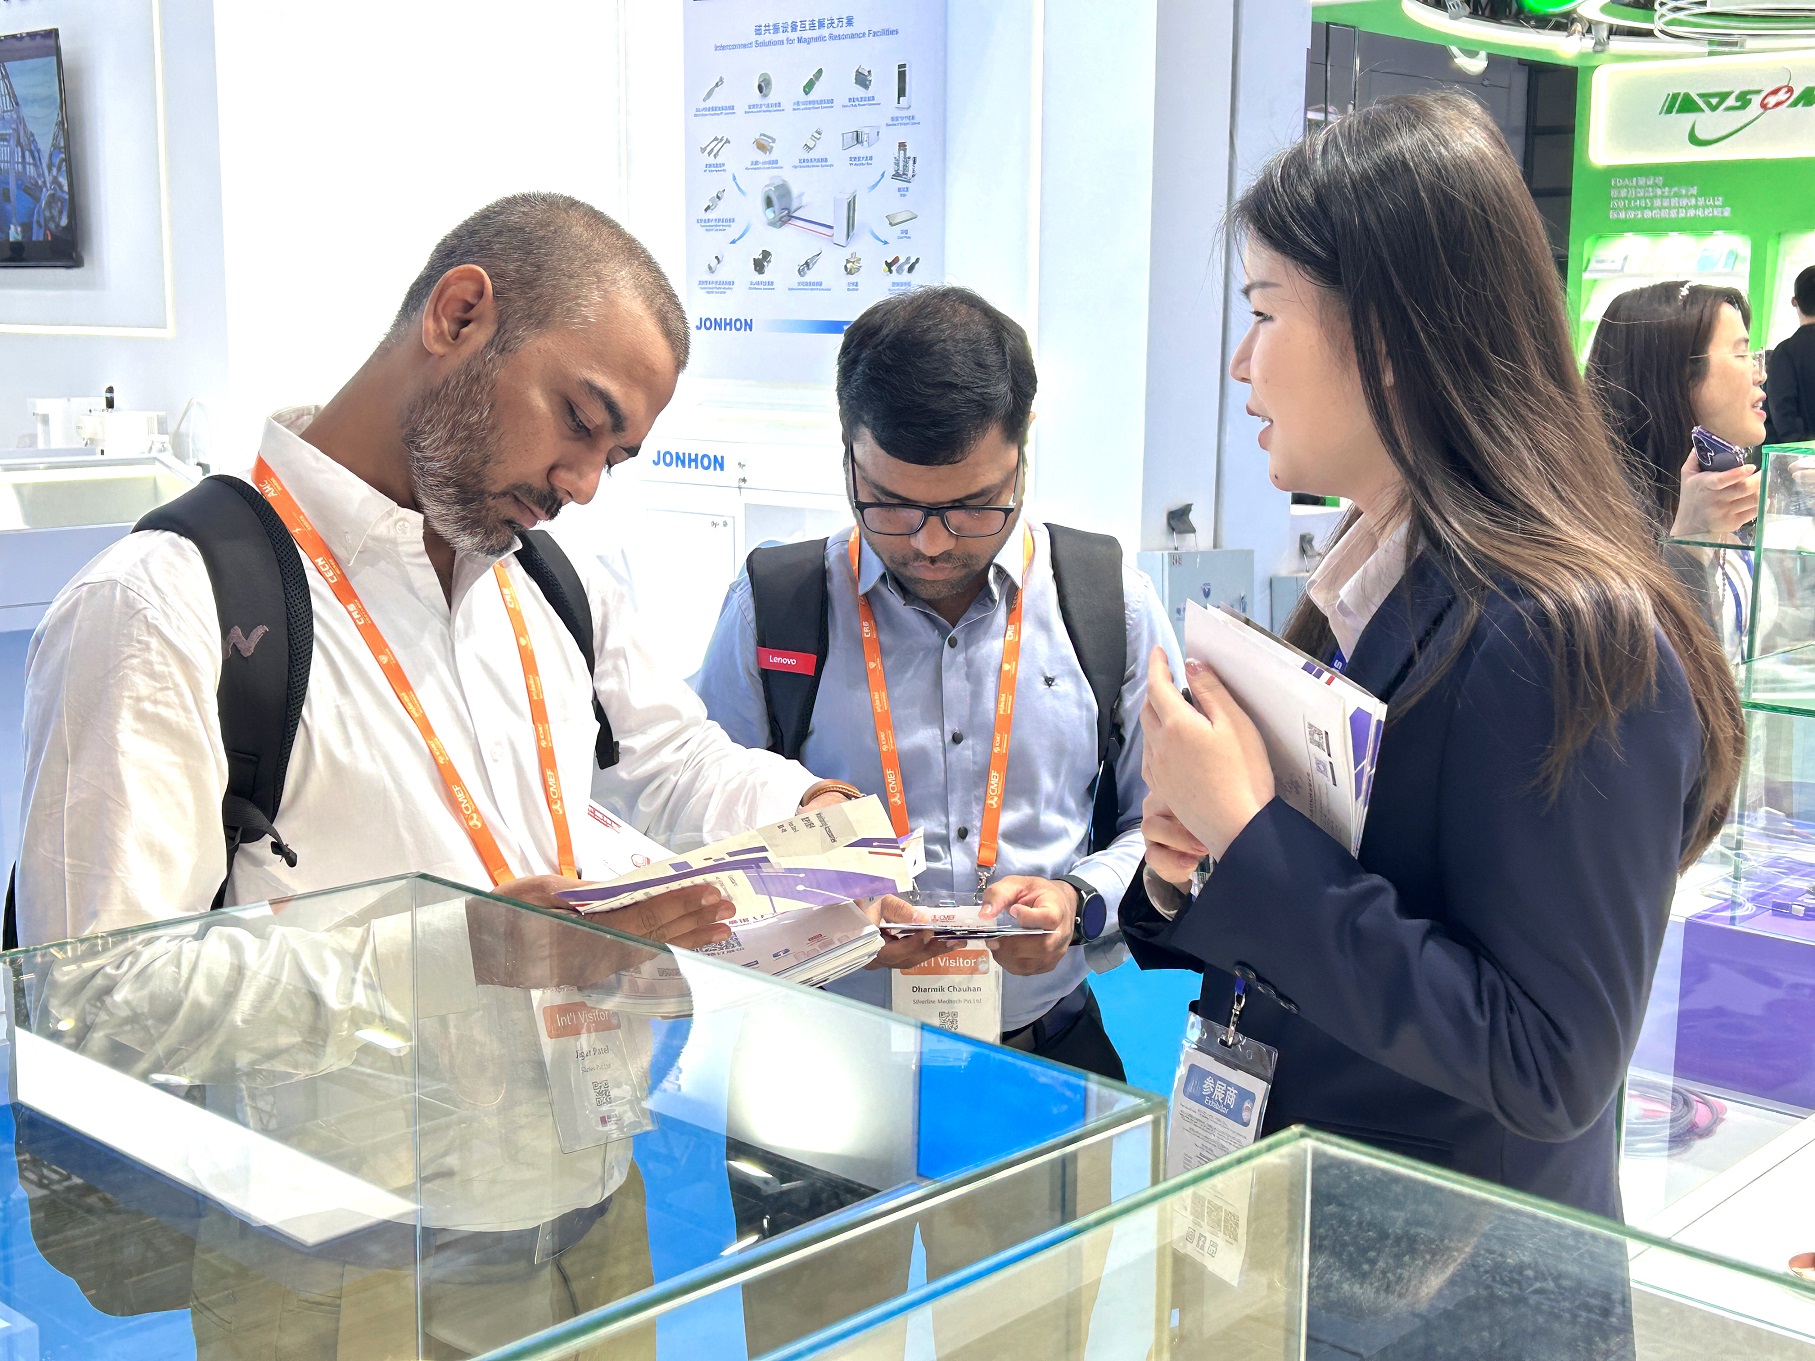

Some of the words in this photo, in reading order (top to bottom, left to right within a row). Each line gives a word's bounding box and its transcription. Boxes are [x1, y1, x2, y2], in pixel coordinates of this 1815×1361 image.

[754, 38, 785, 48] Solutions
[786, 37, 796, 45] for
[797, 34, 827, 45] Magnetic
[828, 31, 867, 41] Resonance
[867, 28, 900, 38] Facilities
[695, 317, 753, 332] JONHON
[652, 450, 725, 471] JONHON
[314, 556, 338, 584] CECN
[769, 655, 797, 665] Lenovo
[545, 768, 560, 799] CMEF
[886, 767, 899, 793] CMEF
[989, 770, 1000, 796] CMEF
[451, 784, 473, 816] CMEF
[938, 957, 976, 967] Visitor
[912, 985, 945, 993] Dharmik
[947, 985, 982, 993] Chauhan
[556, 1012, 577, 1027] Int'l
[578, 1011, 609, 1023] Visitor
[1202, 1076, 1238, 1109] 参展商
